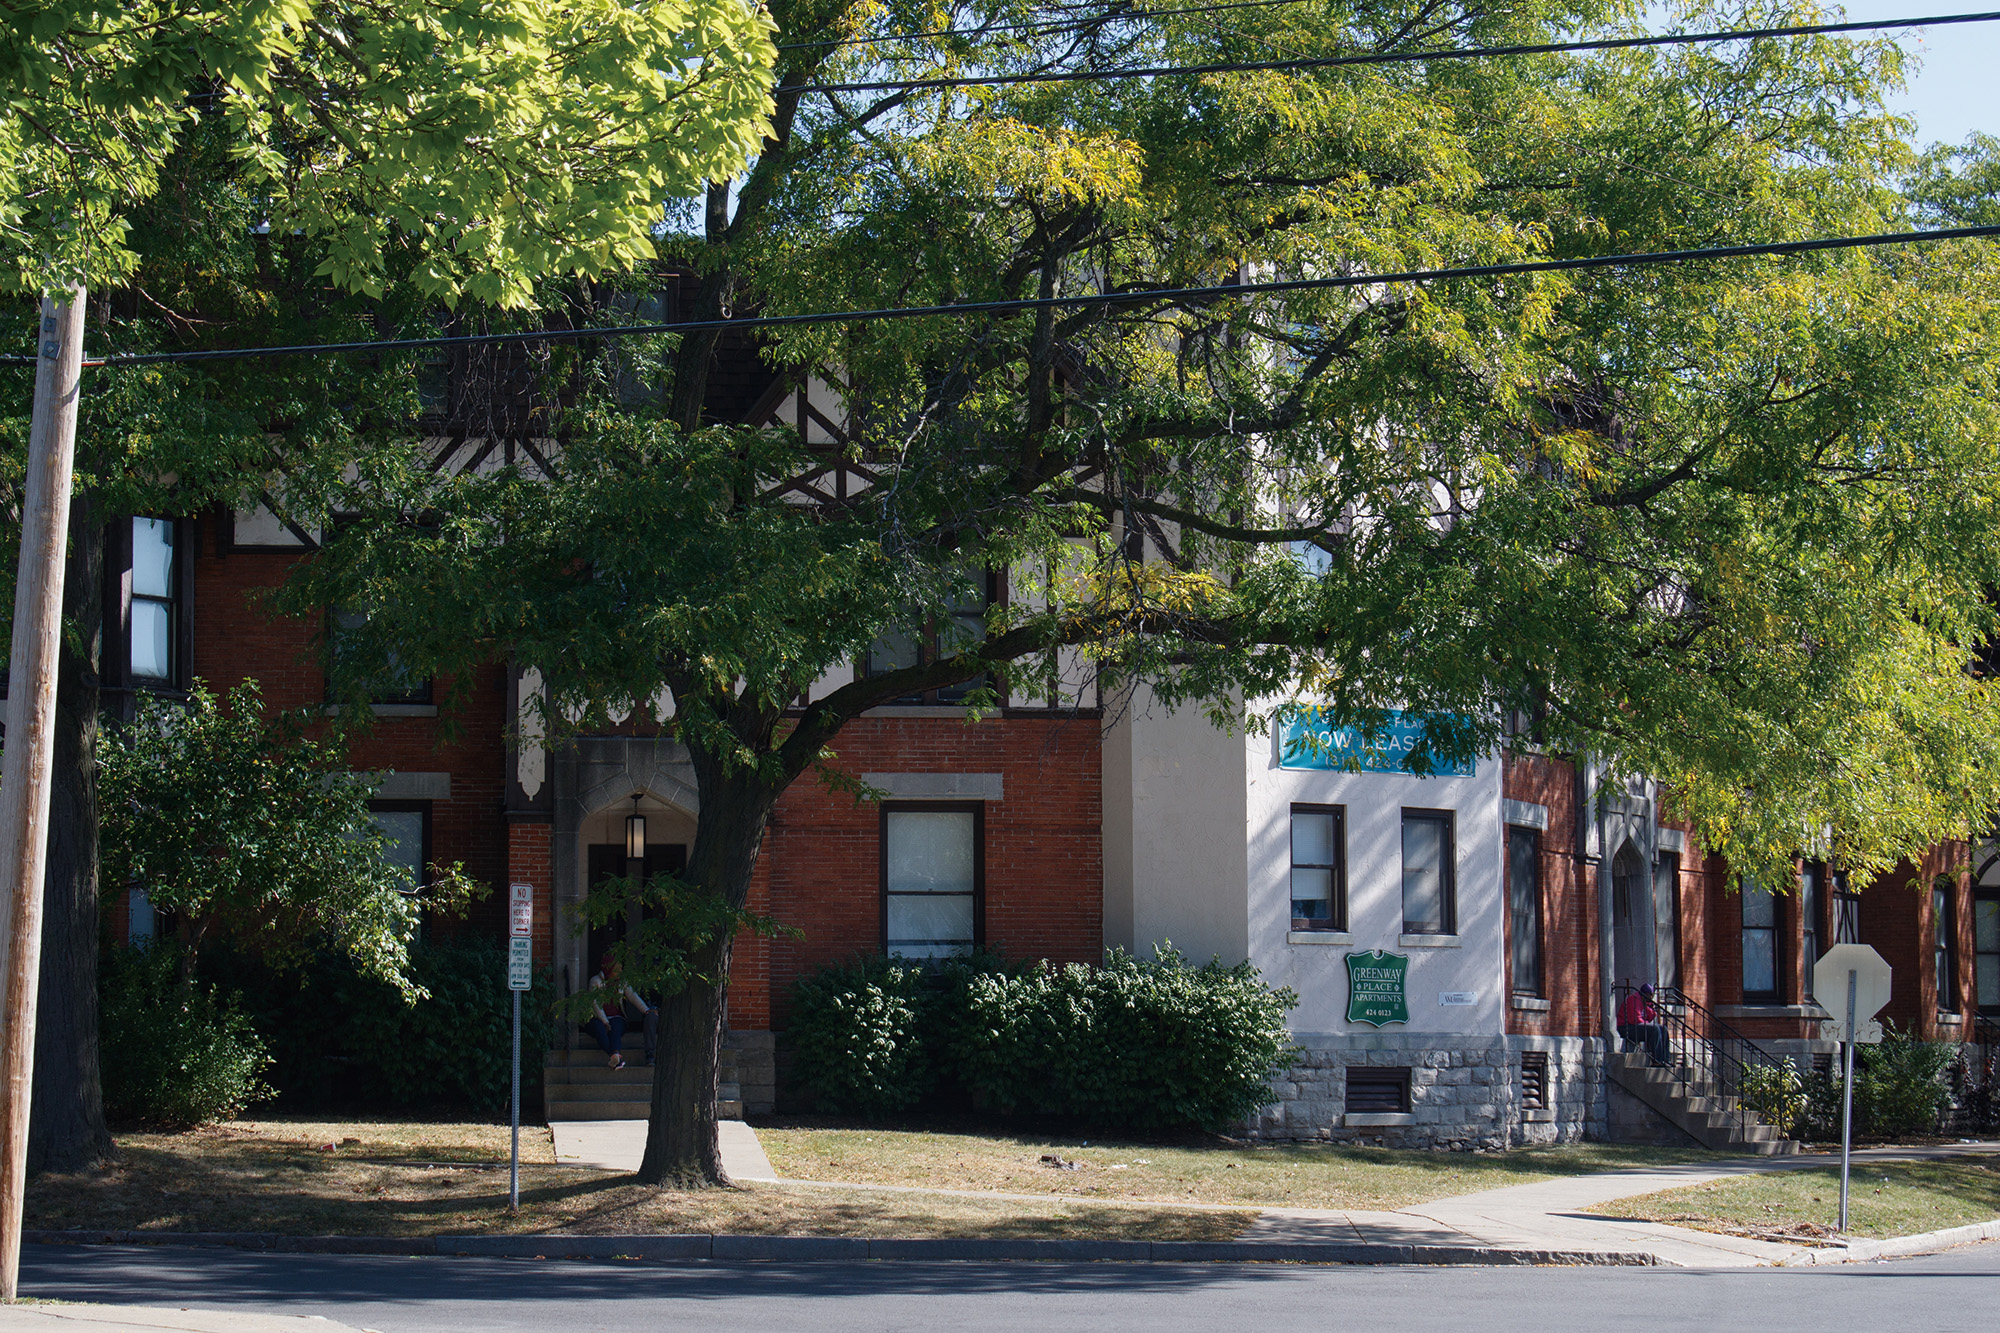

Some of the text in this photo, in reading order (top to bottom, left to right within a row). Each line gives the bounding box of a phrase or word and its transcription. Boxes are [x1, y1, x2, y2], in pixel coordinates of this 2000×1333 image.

[517, 888, 526, 898] NO
[525, 909, 530, 917] TO
[512, 949, 529, 957] PERMITTED
[1353, 967, 1402, 983] GREENWAY
[1363, 982, 1393, 991] PLACE
[1354, 993, 1402, 1003] APARTMENTS
[1365, 1008, 1377, 1016] 424
